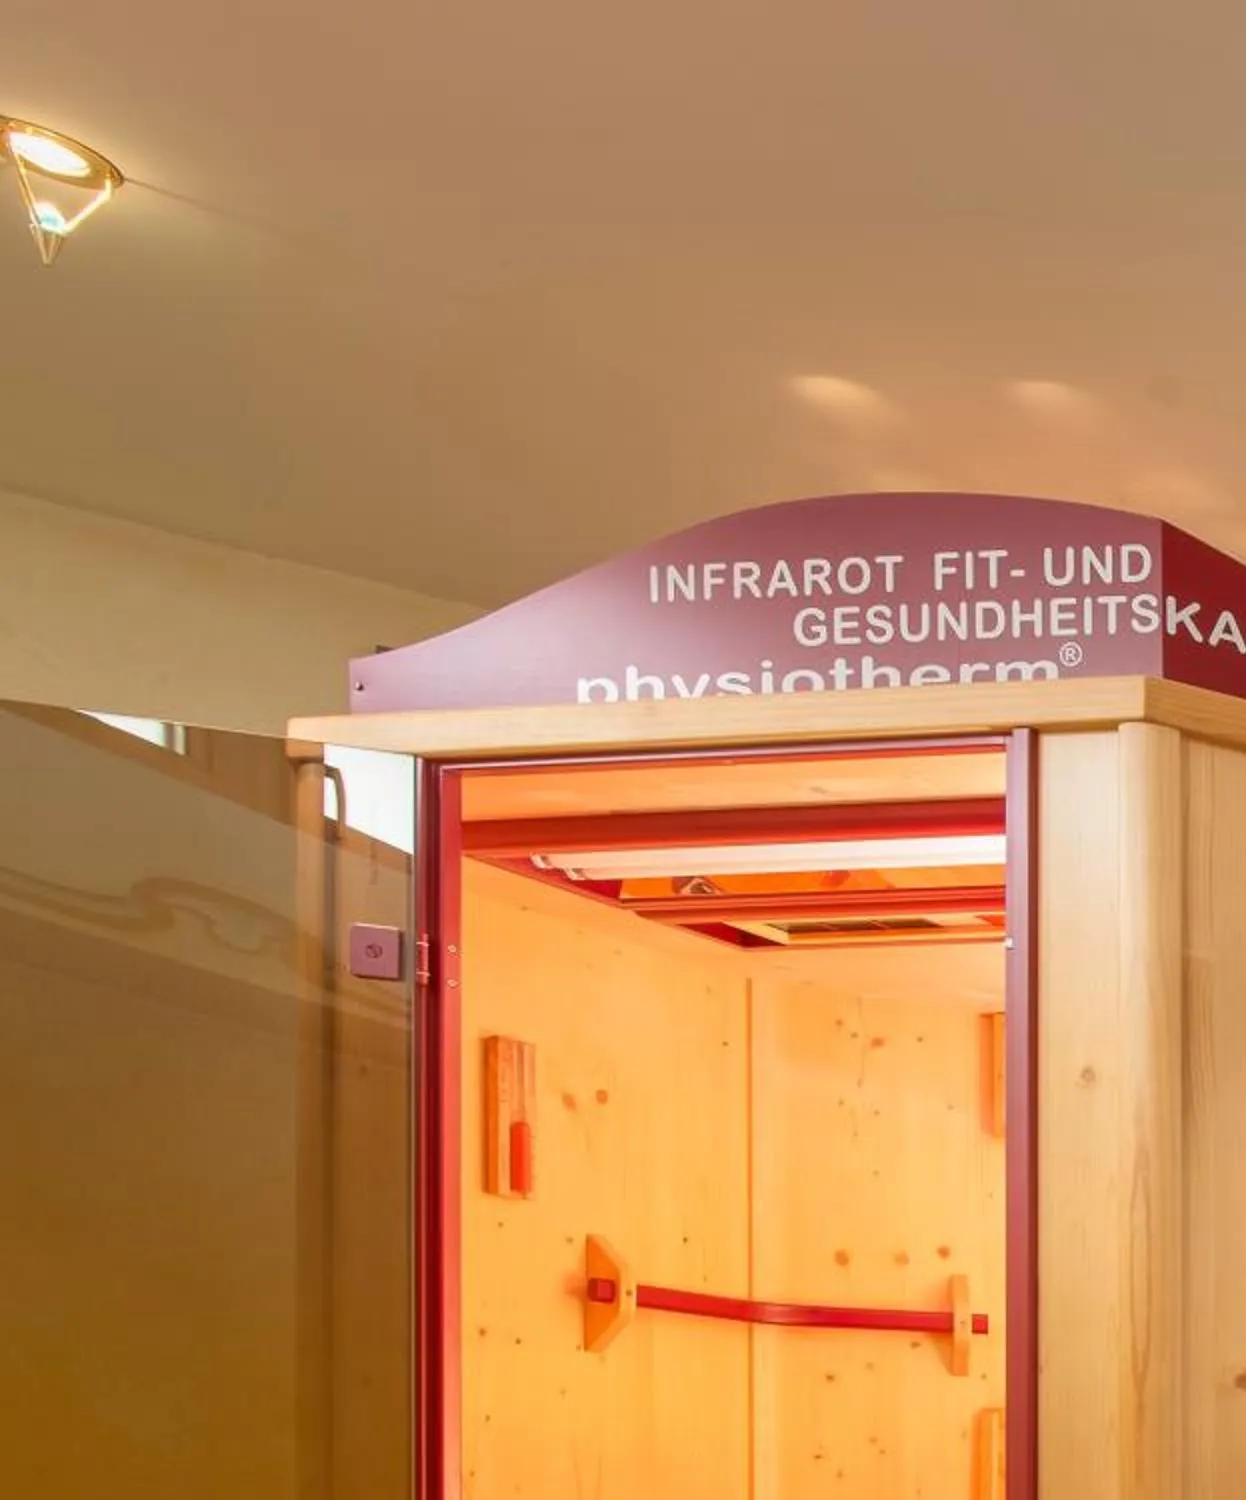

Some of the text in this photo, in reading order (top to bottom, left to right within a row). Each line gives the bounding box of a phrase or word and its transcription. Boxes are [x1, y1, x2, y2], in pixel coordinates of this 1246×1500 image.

[648, 543, 1153, 602] INFRAROT FIT- UND
